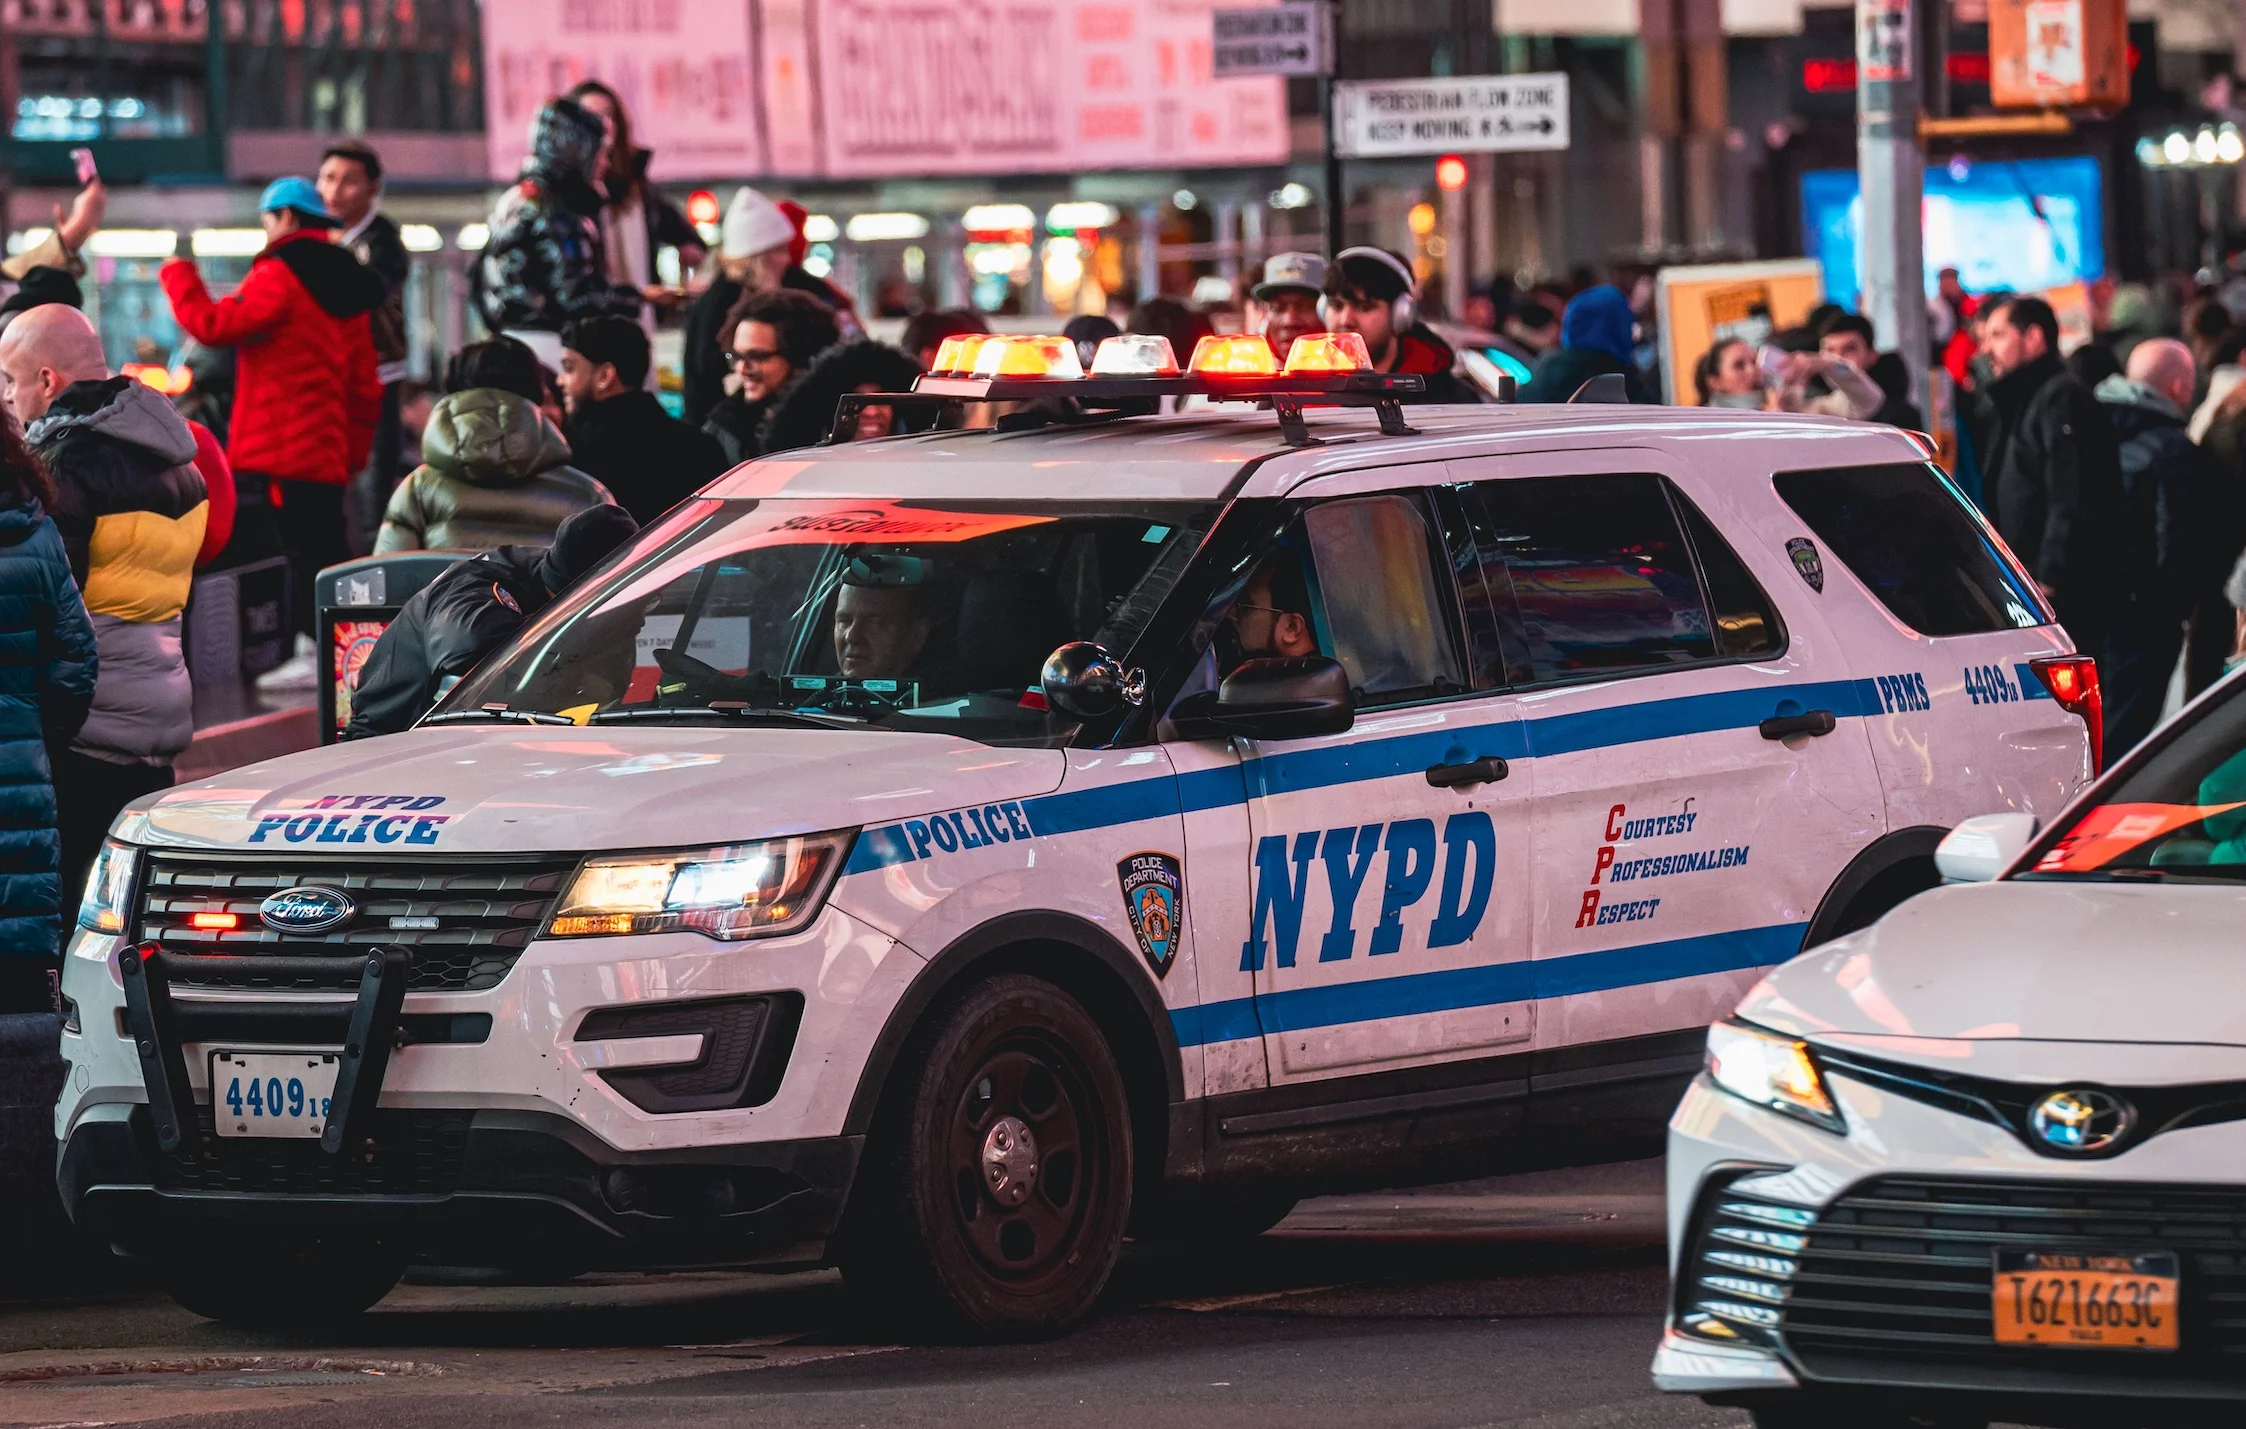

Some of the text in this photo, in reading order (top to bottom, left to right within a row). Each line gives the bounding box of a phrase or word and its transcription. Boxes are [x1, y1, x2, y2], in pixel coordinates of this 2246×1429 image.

[1877, 672, 1930, 713] PBMS
[303, 795, 446, 810] NYPD
[248, 813, 450, 845] POLICE
[905, 801, 1032, 860] POLICE
[1123, 868, 1178, 892] DEPARTMENT
[1132, 856, 1163, 871] POLICE
[275, 893, 329, 918] Ford
[1239, 811, 1496, 972] NYPD
[1128, 905, 1152, 954] CITY OF
[1167, 898, 1181, 959] NEW YORK
[2010, 1276, 2162, 1329] T621663C
